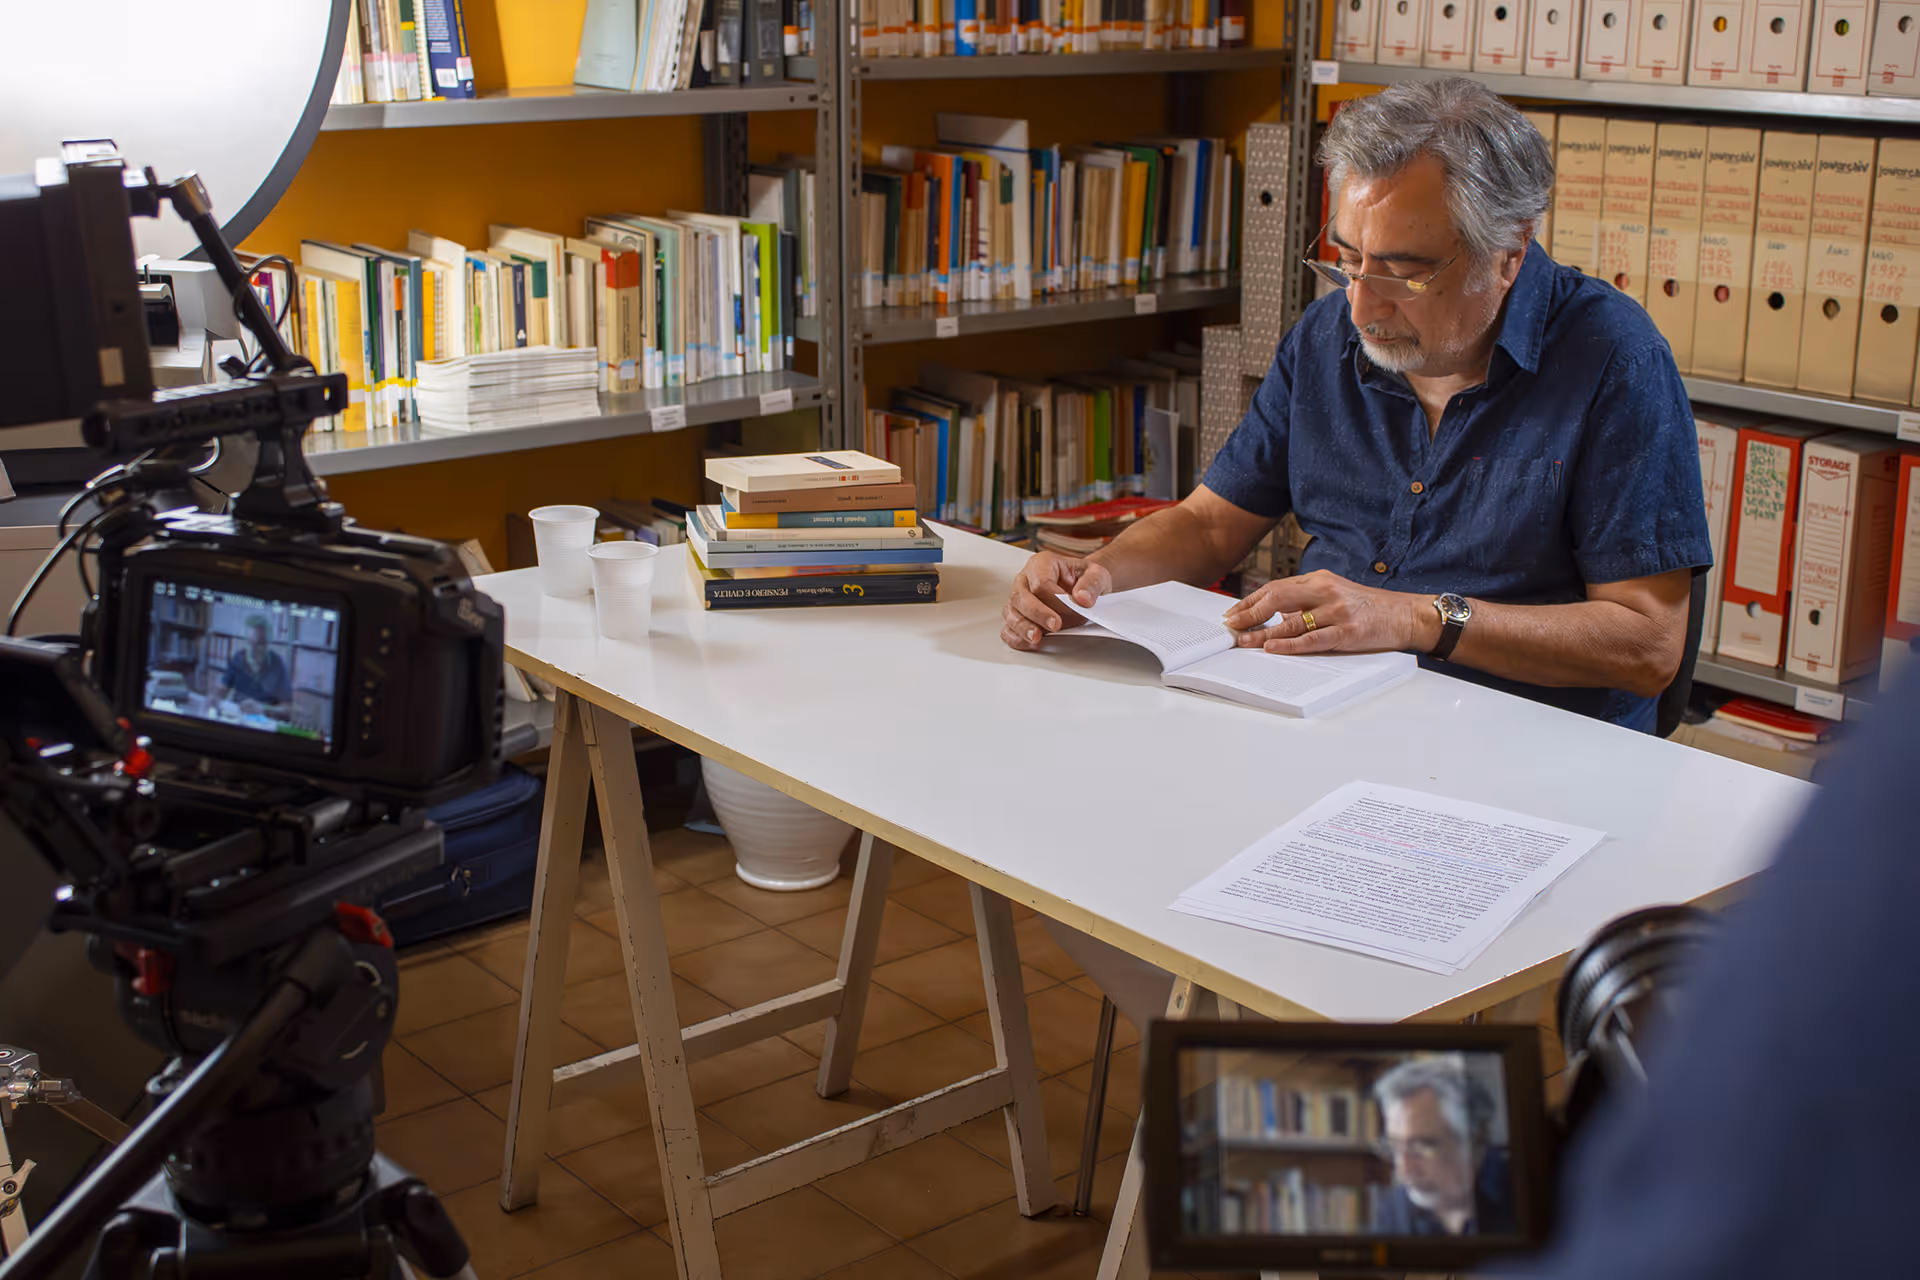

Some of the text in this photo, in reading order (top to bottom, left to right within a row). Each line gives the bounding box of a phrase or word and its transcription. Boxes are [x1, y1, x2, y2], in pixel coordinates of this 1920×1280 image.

[1815, 268, 1857, 289] 1986
[1808, 455, 1851, 472] STORAGE
[745, 589, 751, 597] E
[751, 588, 788, 597] PENSIERO
[842, 584, 864, 597] 3
